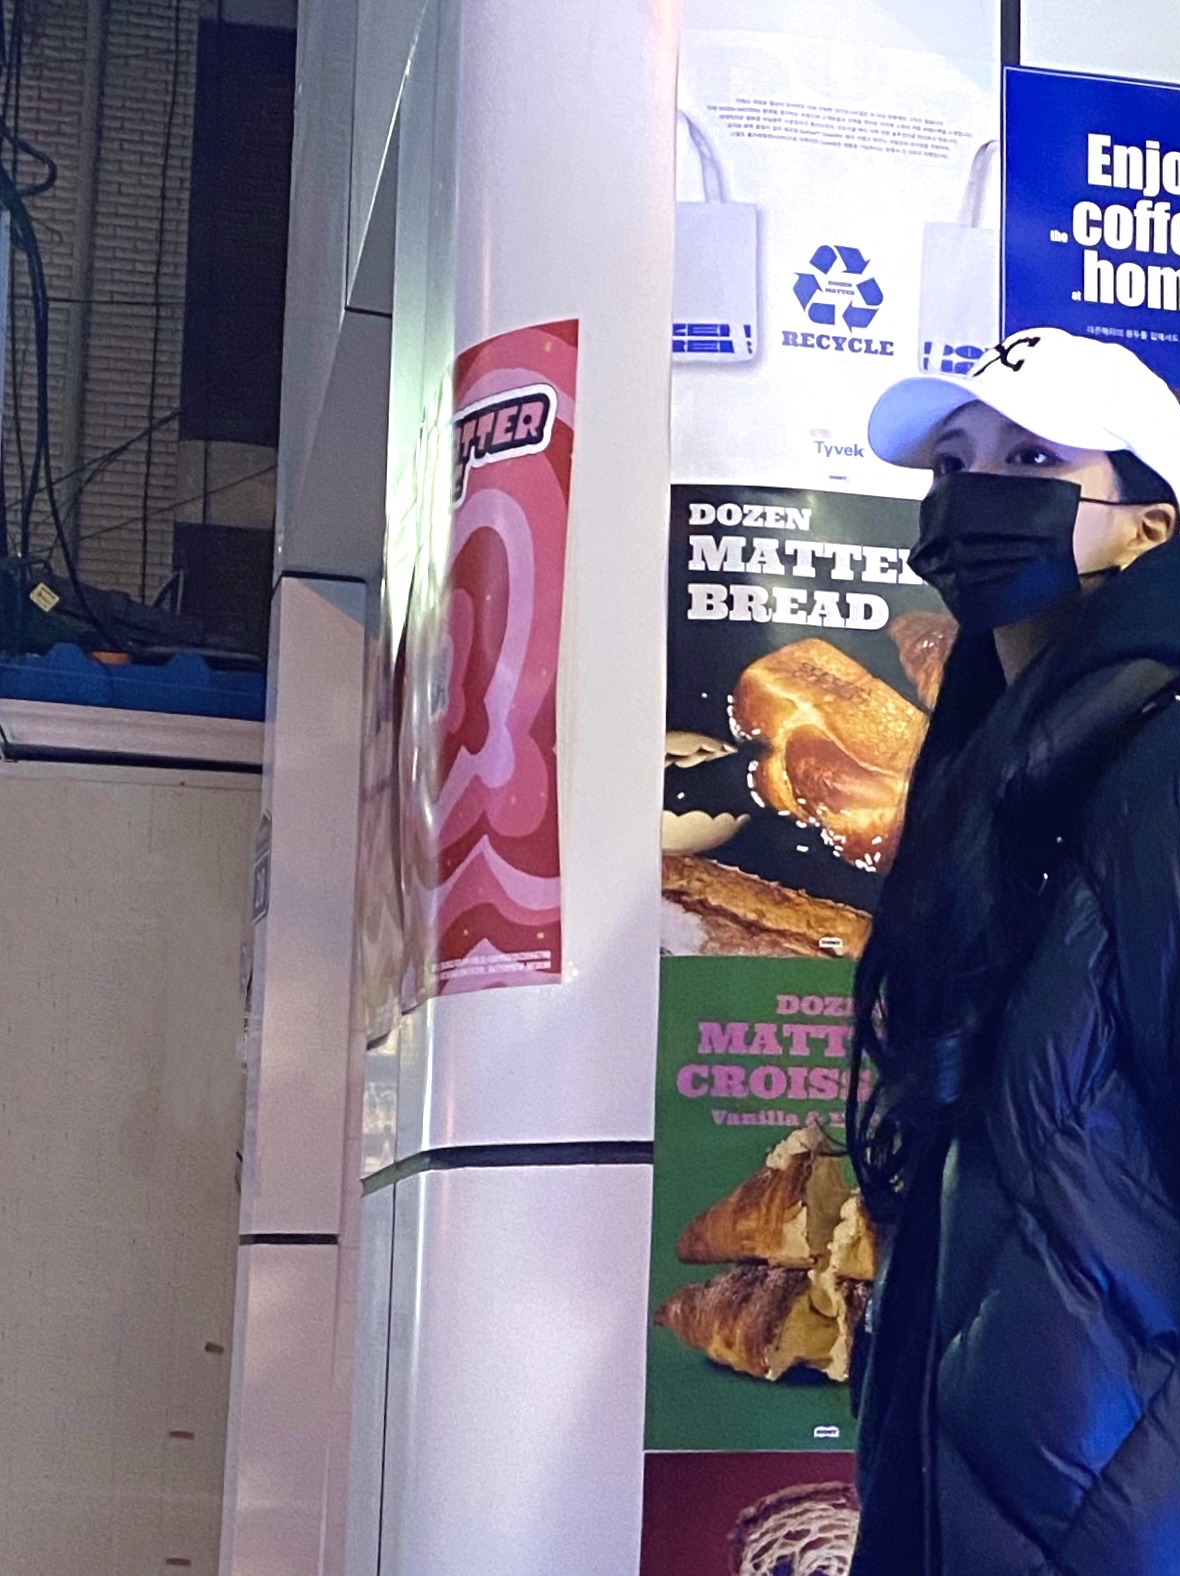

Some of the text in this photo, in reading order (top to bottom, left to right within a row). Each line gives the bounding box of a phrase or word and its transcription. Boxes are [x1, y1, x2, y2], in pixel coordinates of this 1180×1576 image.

[782, 330, 895, 356] RECYCLE
[813, 440, 866, 458] Tyvek
[688, 503, 812, 531] DOZEN
[687, 583, 890, 631] BREAD
[698, 1022, 854, 1058] MATT
[711, 1109, 800, 1127] Vanilla
